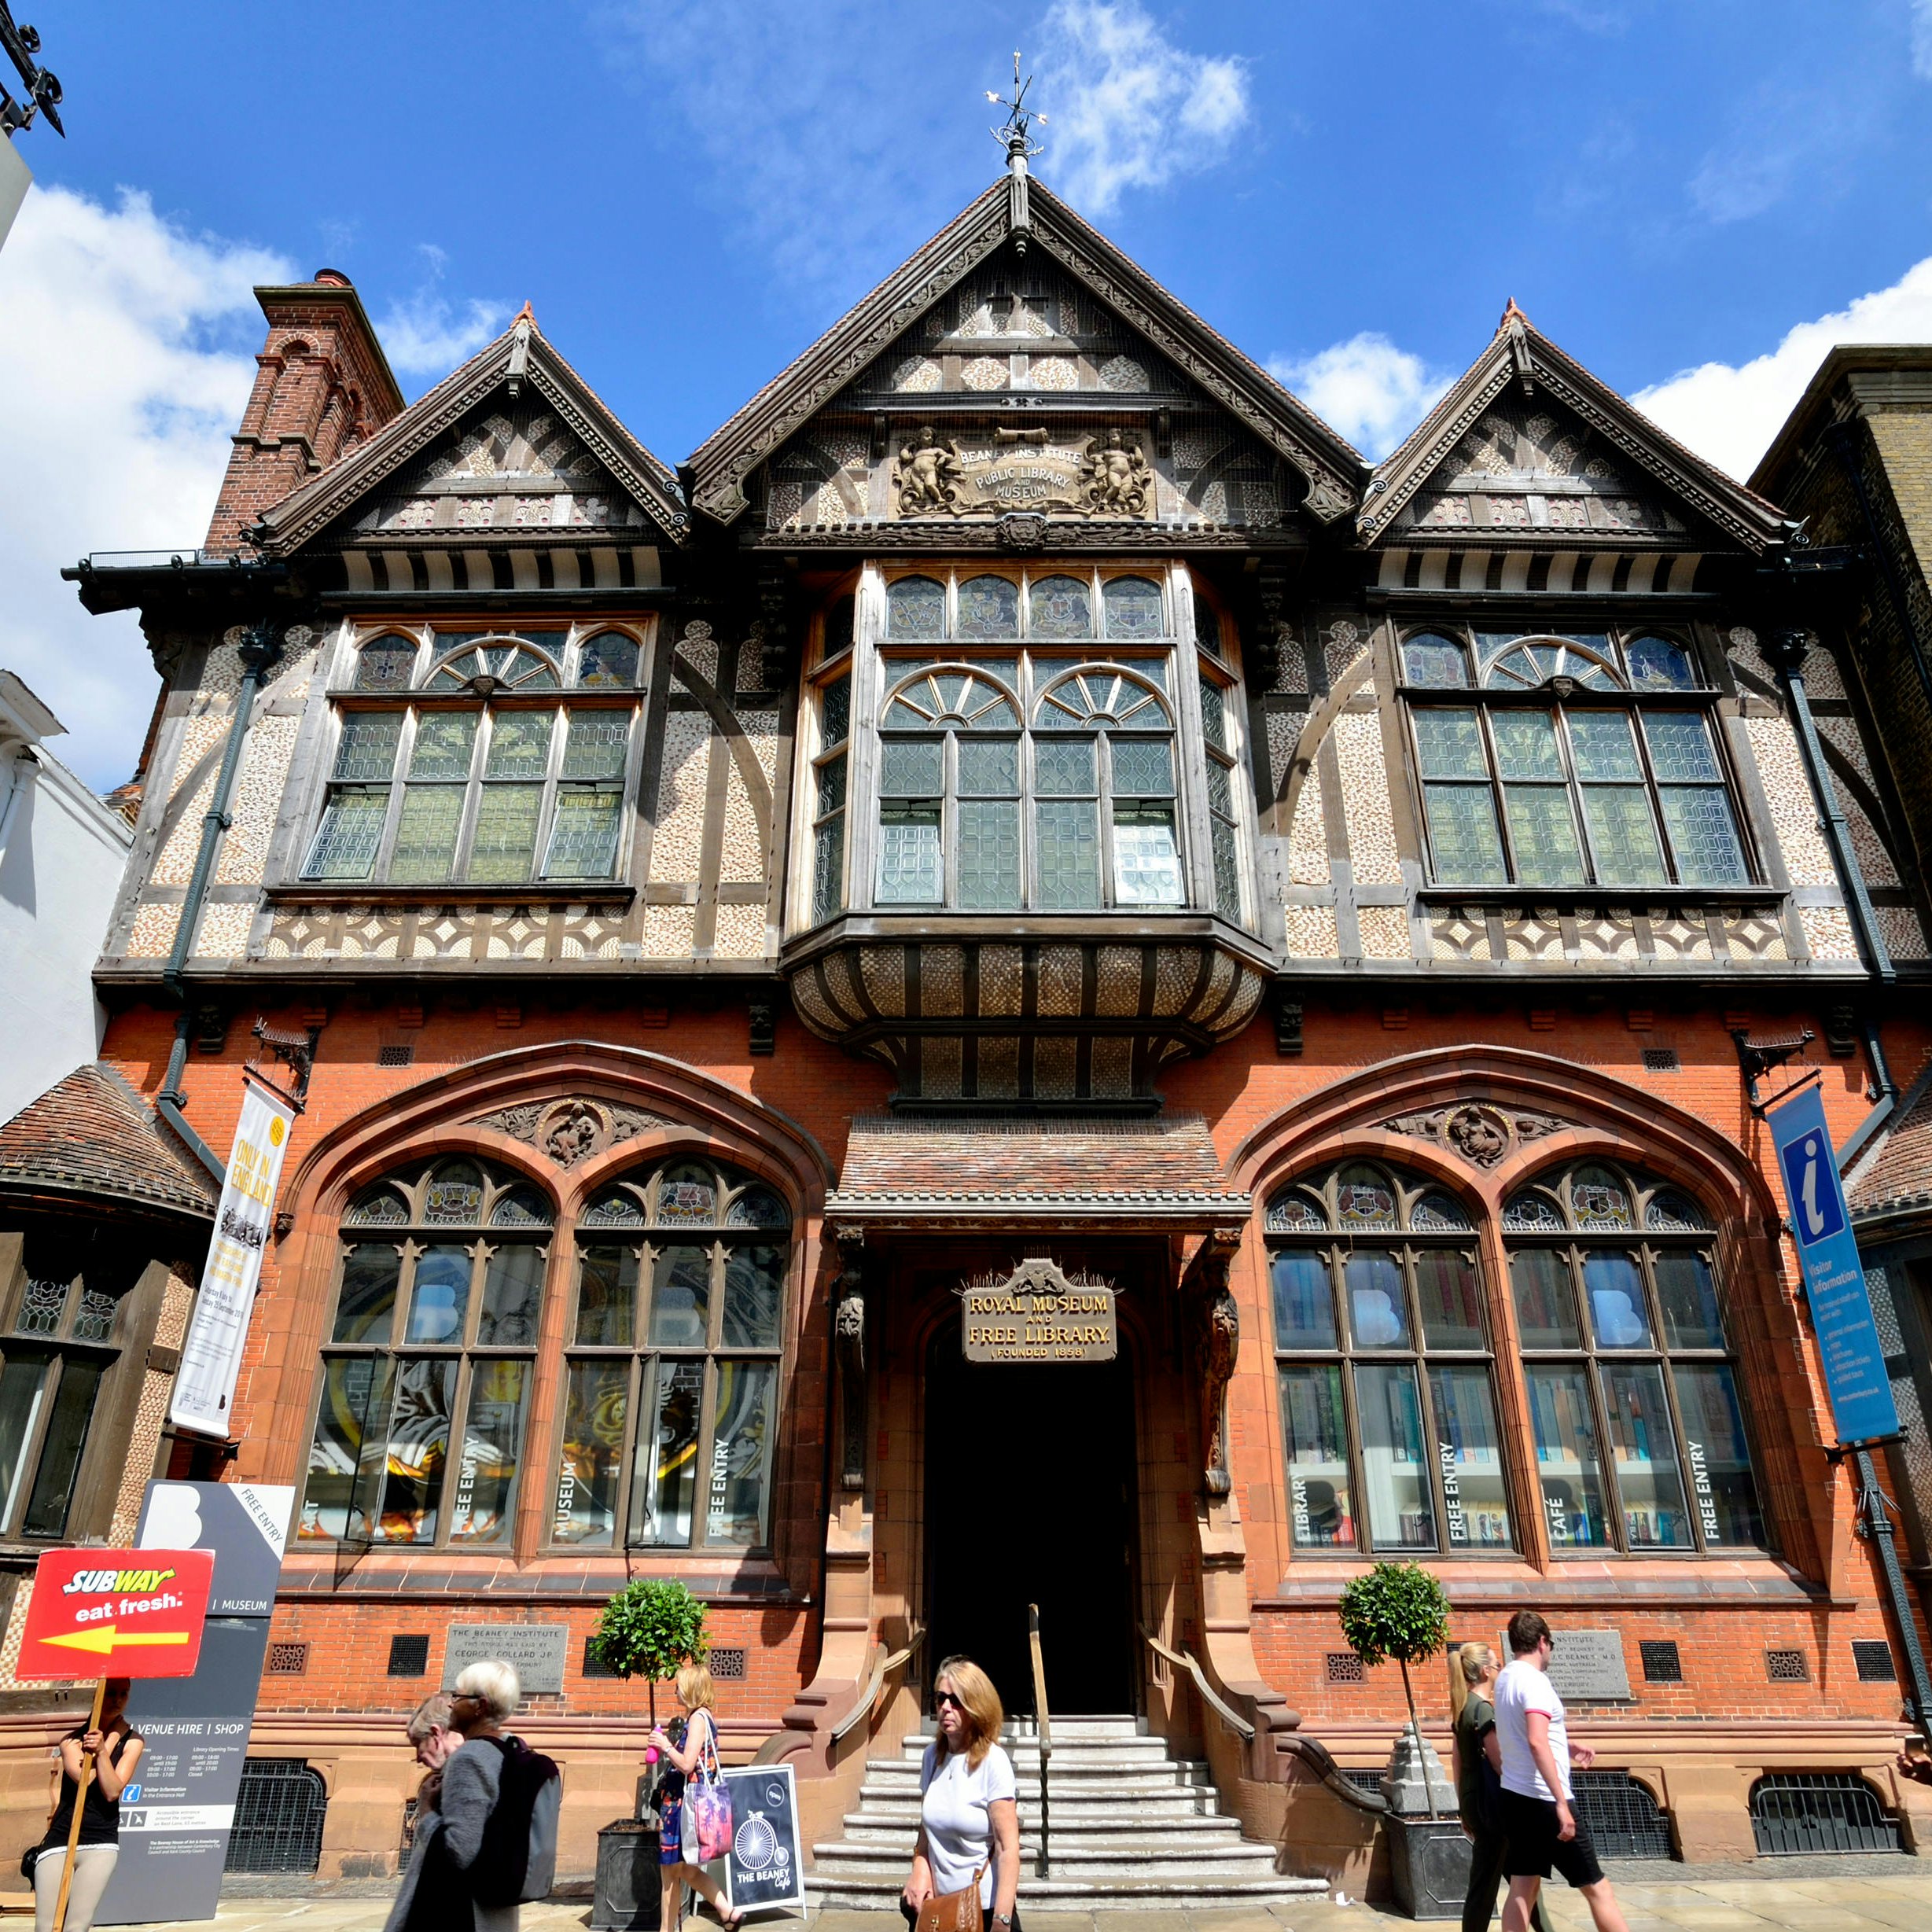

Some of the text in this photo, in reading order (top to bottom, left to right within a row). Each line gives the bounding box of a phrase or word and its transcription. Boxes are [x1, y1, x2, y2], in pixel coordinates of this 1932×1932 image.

[959, 449, 1082, 464] BEANEY INSTITUTE
[975, 467, 1070, 489] PUBLIC LIBRARY
[995, 484, 1047, 499] MUSEUM
[237, 1139, 270, 1178] ONLY IN
[231, 1164, 273, 1208] ENGLAND
[1809, 1260, 1832, 1276] Visitor
[970, 1296, 1108, 1314] ROYAL MUSEUM
[1025, 1316, 1053, 1324] AND
[969, 1327, 1110, 1345] FREE LIBRARY.
[1439, 1441, 1459, 1496] ENTRY
[1687, 1441, 1713, 1494] ENTRY
[452, 1437, 480, 1534] FREE ENTRY
[555, 1462, 576, 1536] MUSEUM
[709, 1438, 730, 1537] FREE ENTRY
[241, 1489, 283, 1542] FREE ENTRY
[301, 1500, 318, 1533] ART
[1290, 1473, 1311, 1542] LIBRARY
[1446, 1500, 1464, 1541] FREE
[1544, 1497, 1567, 1540] CAFÉ
[1698, 1498, 1720, 1539] FREE
[61, 1566, 176, 1596] SUBWAY
[75, 1602, 112, 1622] eat
[222, 1599, 267, 1610] MUSEUM
[138, 1724, 244, 1735] VENUE HIRE SHOP
[768, 1790, 782, 1801] open
[737, 1868, 790, 1884] THE BEANEY
